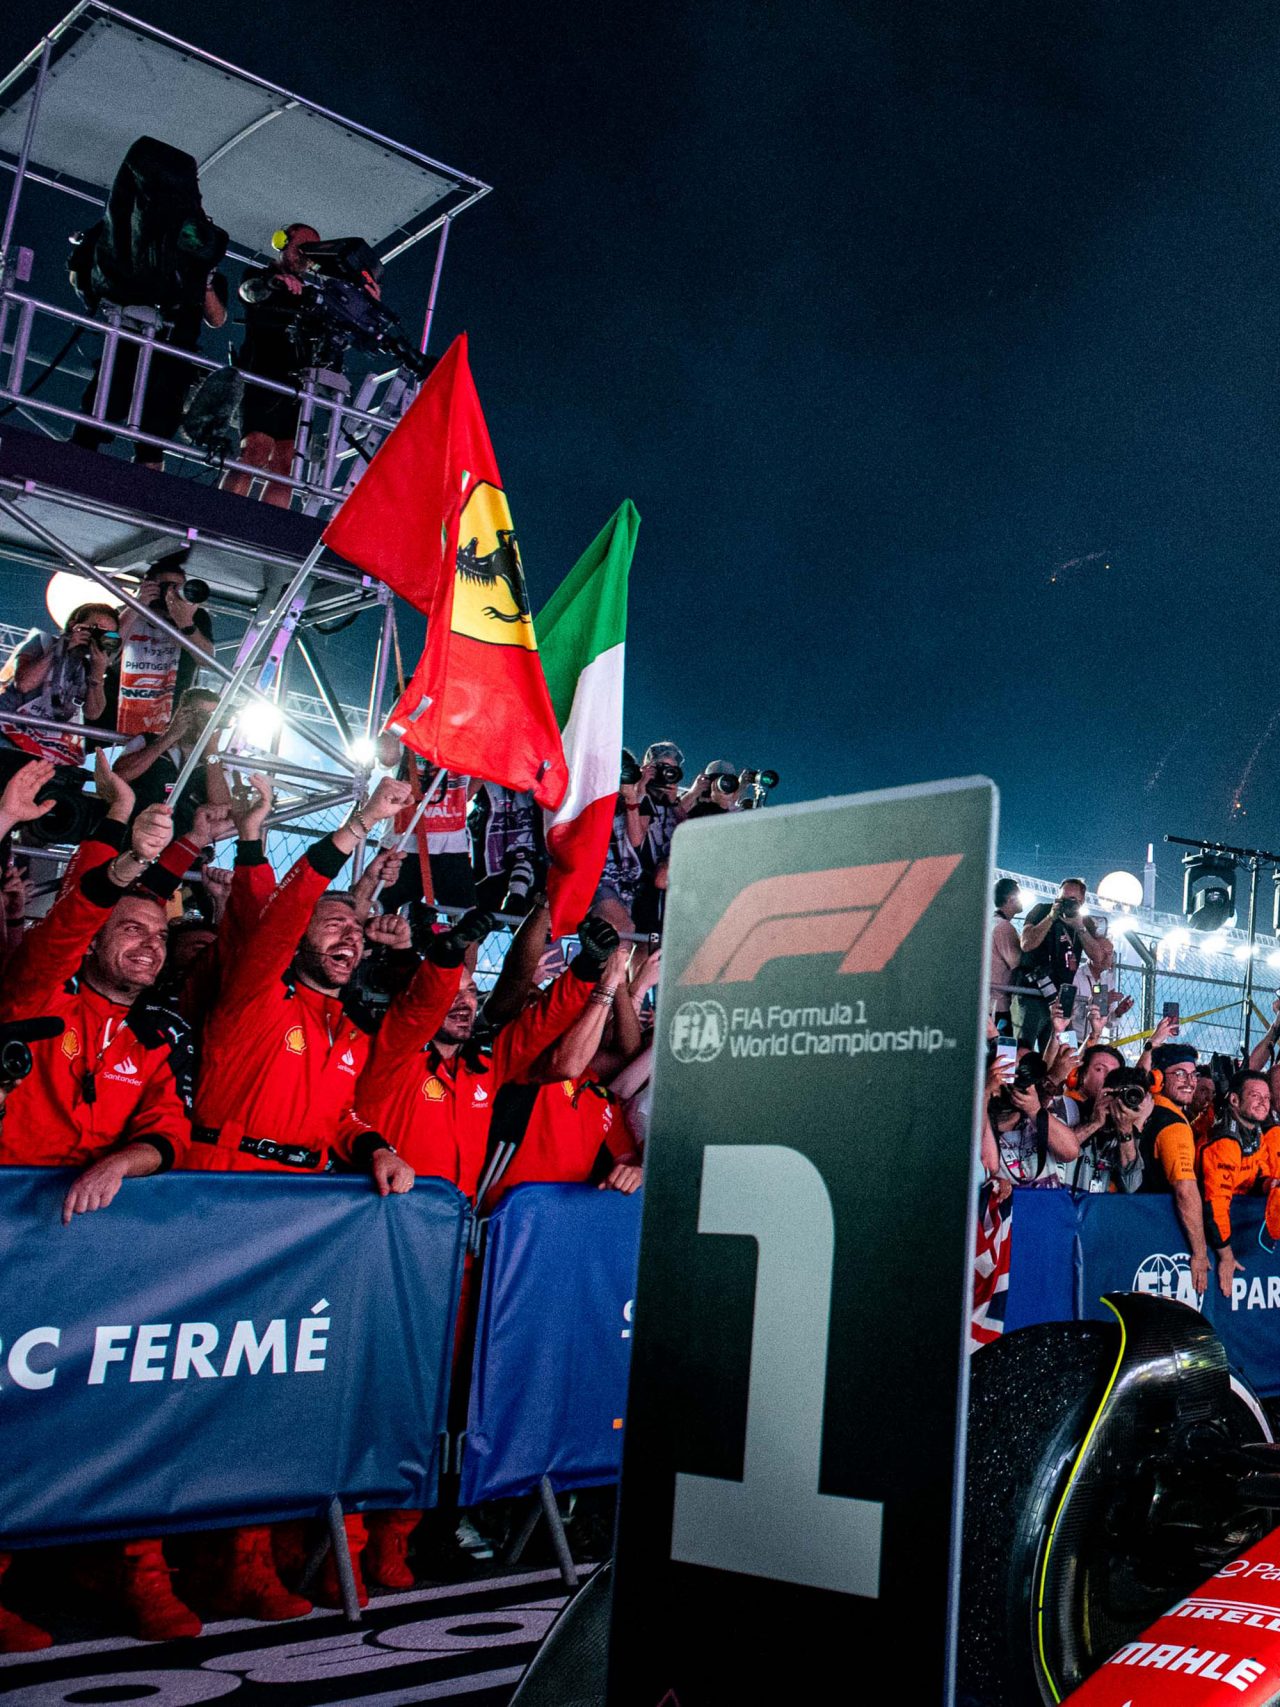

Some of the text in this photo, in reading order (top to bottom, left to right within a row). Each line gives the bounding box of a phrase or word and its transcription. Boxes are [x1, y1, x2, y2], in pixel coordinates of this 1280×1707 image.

[731, 1008, 763, 1031] FIA
[729, 1026, 943, 1058] World Championship
[102, 1071, 143, 1086] Santander
[87, 1298, 331, 1385] FERMÉ
[670, 1145, 884, 1599] 1
[1103, 1642, 1267, 1692] MAHLE
